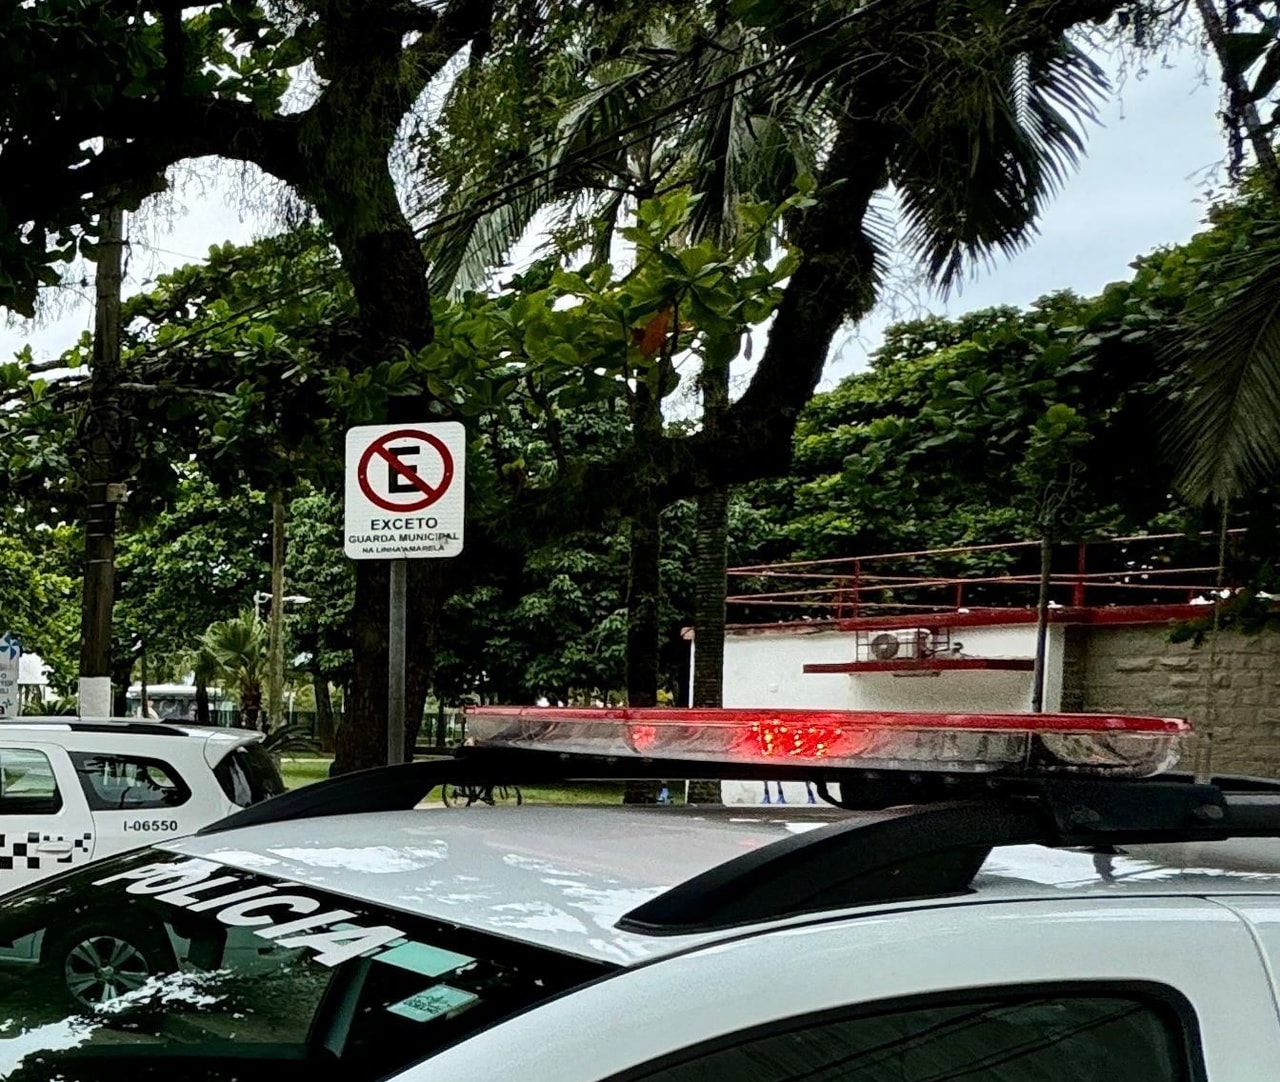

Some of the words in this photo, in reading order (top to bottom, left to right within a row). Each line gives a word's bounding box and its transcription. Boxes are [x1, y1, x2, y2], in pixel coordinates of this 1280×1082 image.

[388, 446, 422, 494] E
[371, 517, 438, 531] EXCETO
[348, 534, 397, 543] GUARDA
[399, 532, 459, 542] MUNICIPAL
[123, 820, 178, 831] I-06550
[91, 857, 408, 968] POLÍCIA
